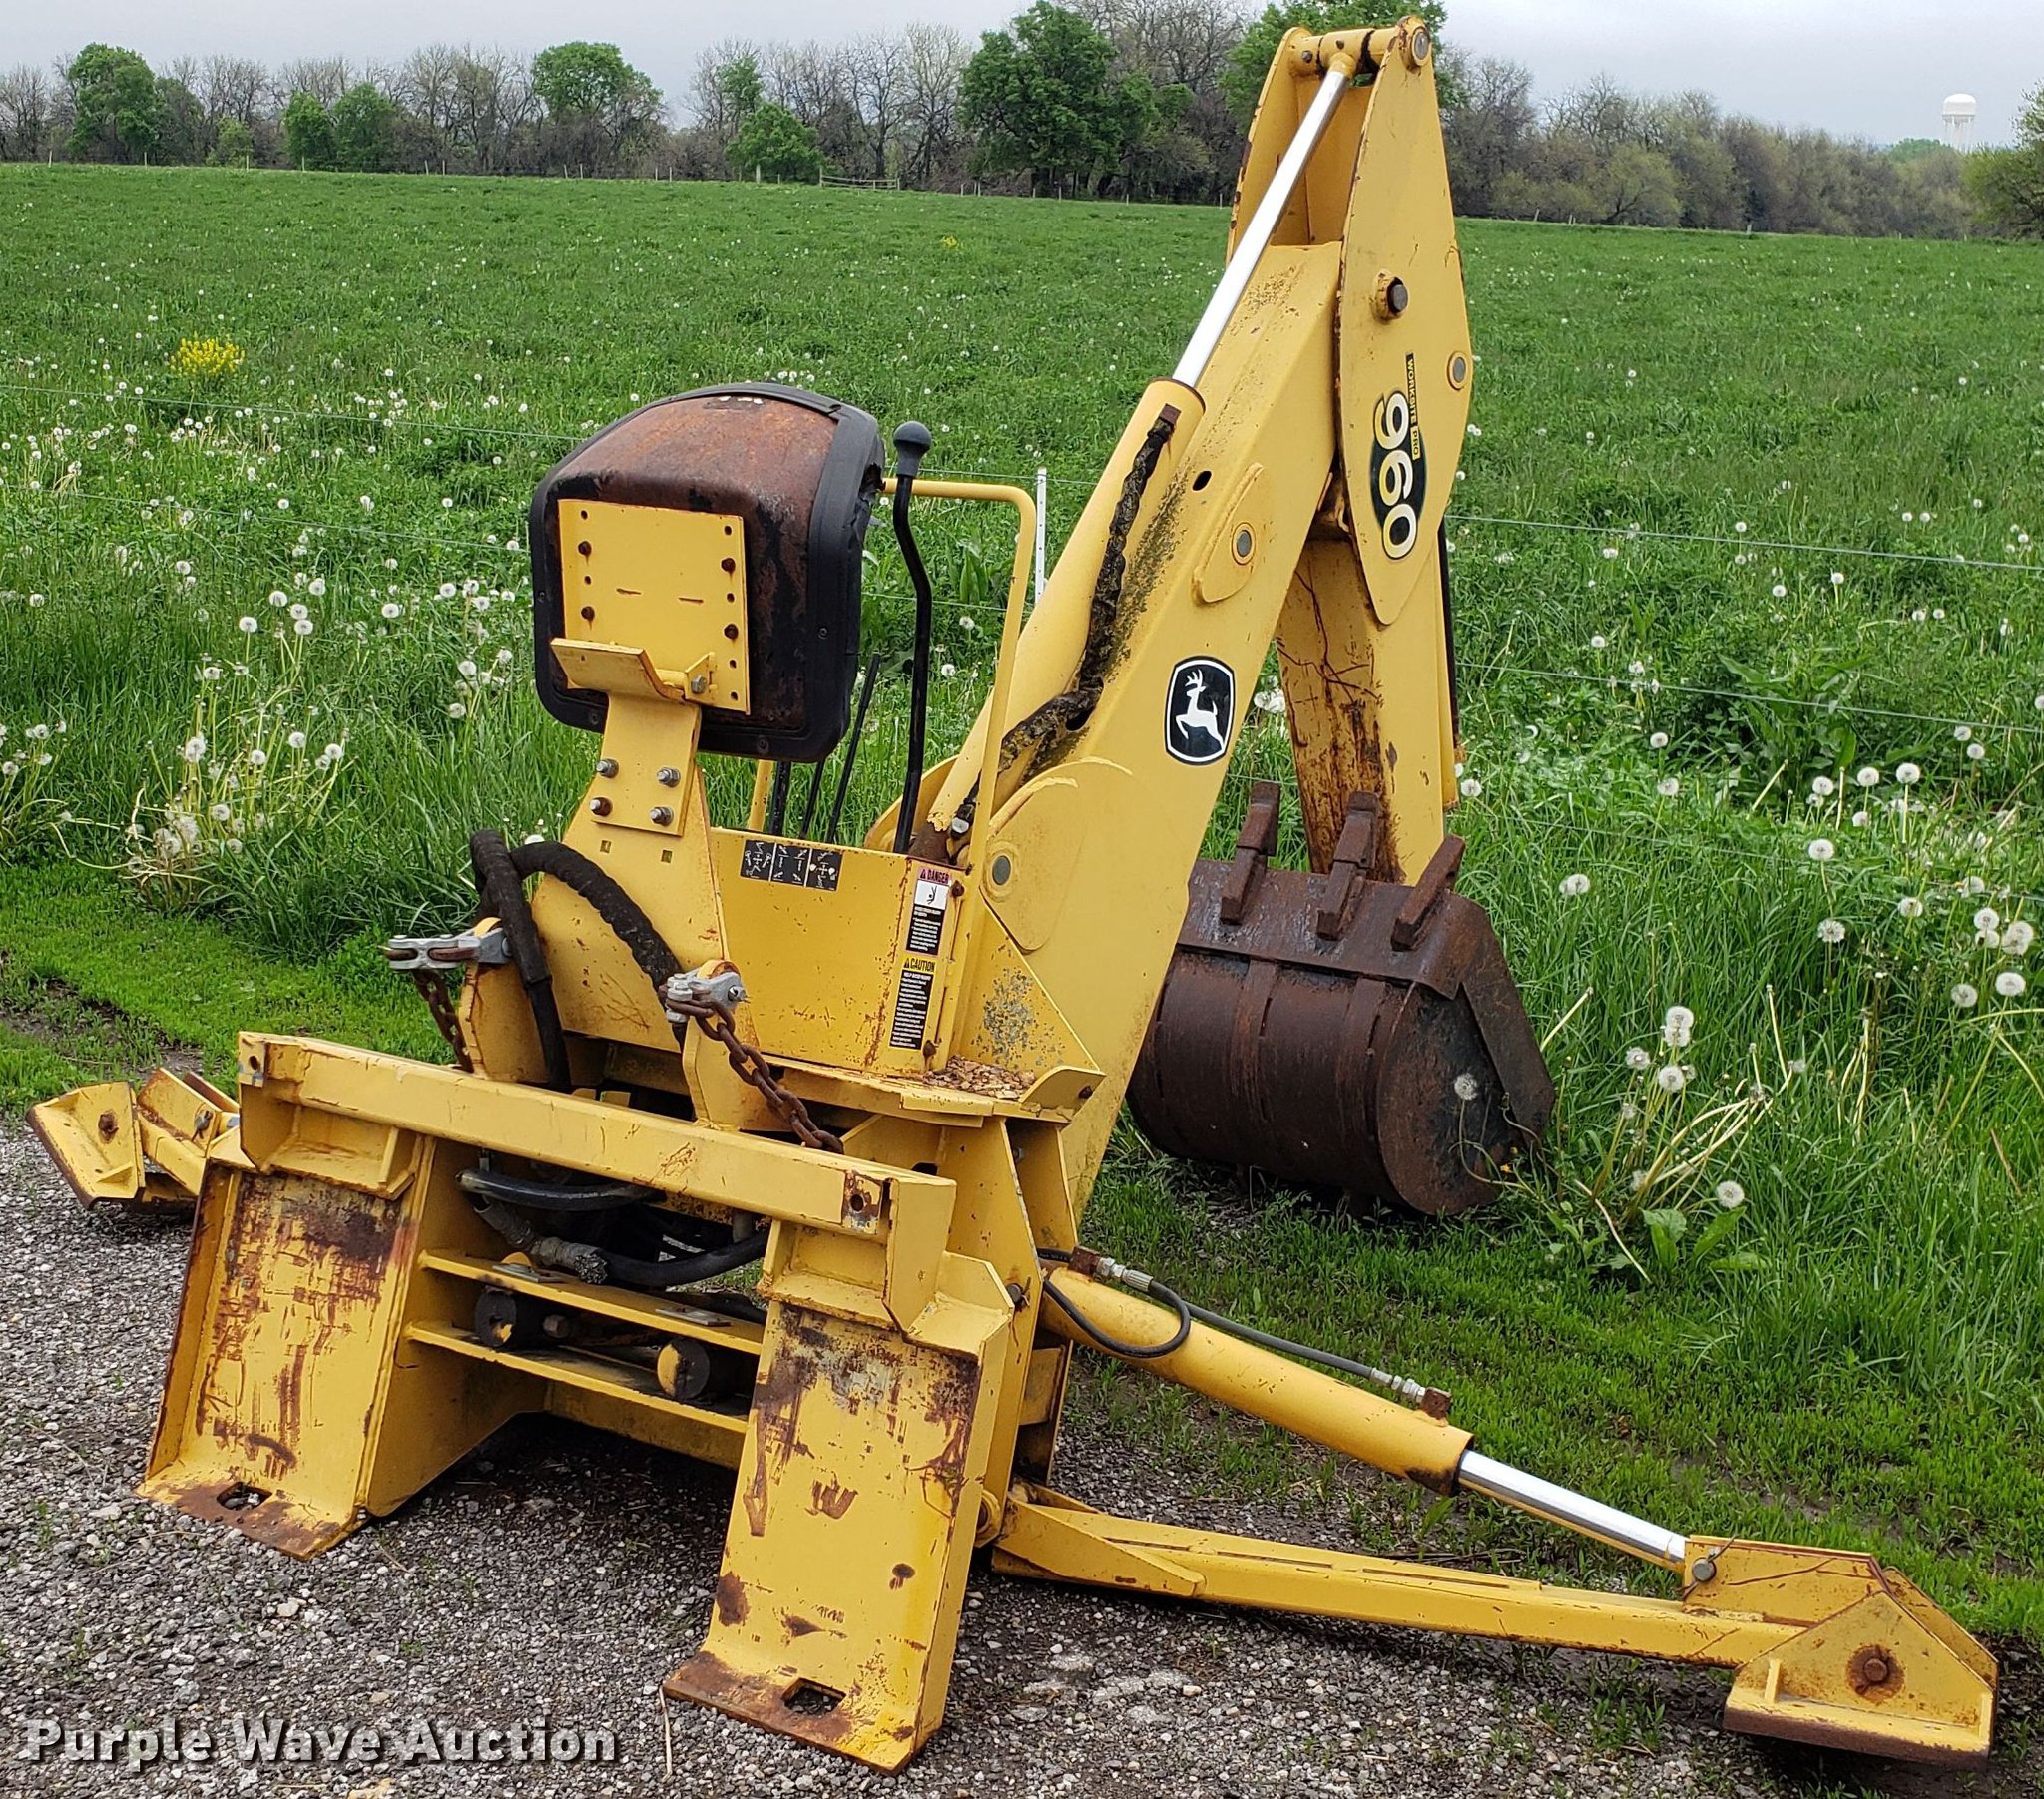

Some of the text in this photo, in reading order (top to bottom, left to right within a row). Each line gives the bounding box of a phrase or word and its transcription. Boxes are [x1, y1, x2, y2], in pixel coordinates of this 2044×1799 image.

[1407, 358, 1420, 455] WORKSITE PRO
[1374, 390, 1417, 559] 960
[927, 868, 950, 885] DANGER
[910, 958, 936, 972] CAUTION
